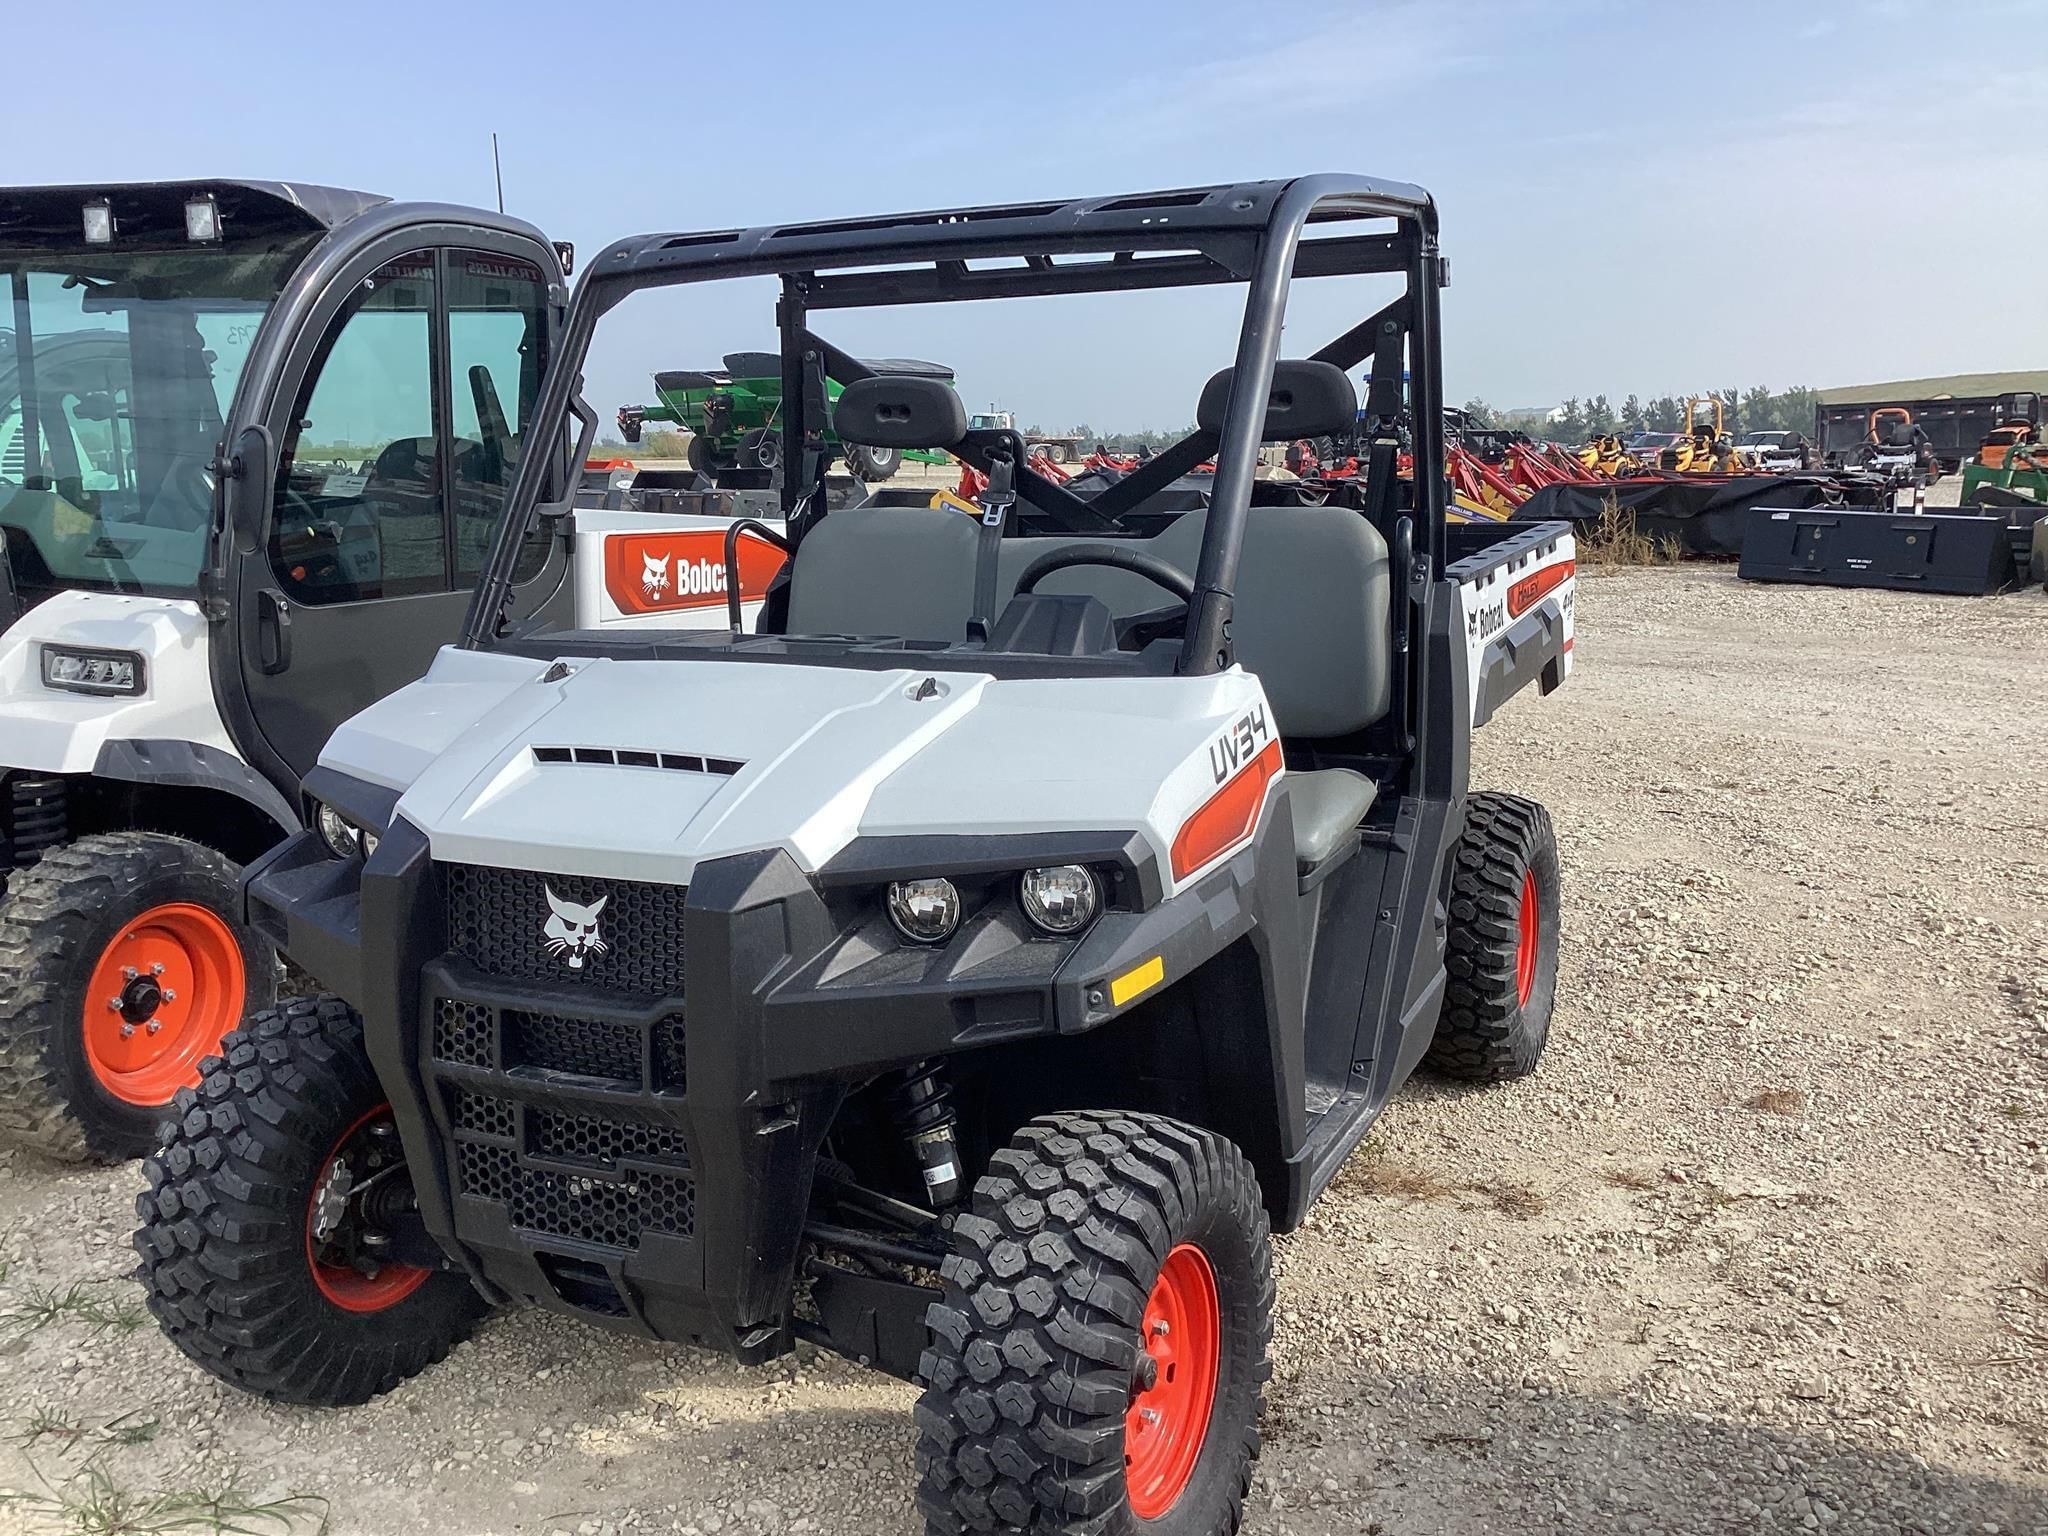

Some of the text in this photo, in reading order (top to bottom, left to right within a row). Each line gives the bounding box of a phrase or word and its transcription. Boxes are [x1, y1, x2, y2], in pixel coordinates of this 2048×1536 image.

[677, 558, 739, 596] Bobca
[1480, 598, 1503, 640] Bobcat
[1209, 703, 1267, 785] UV34
